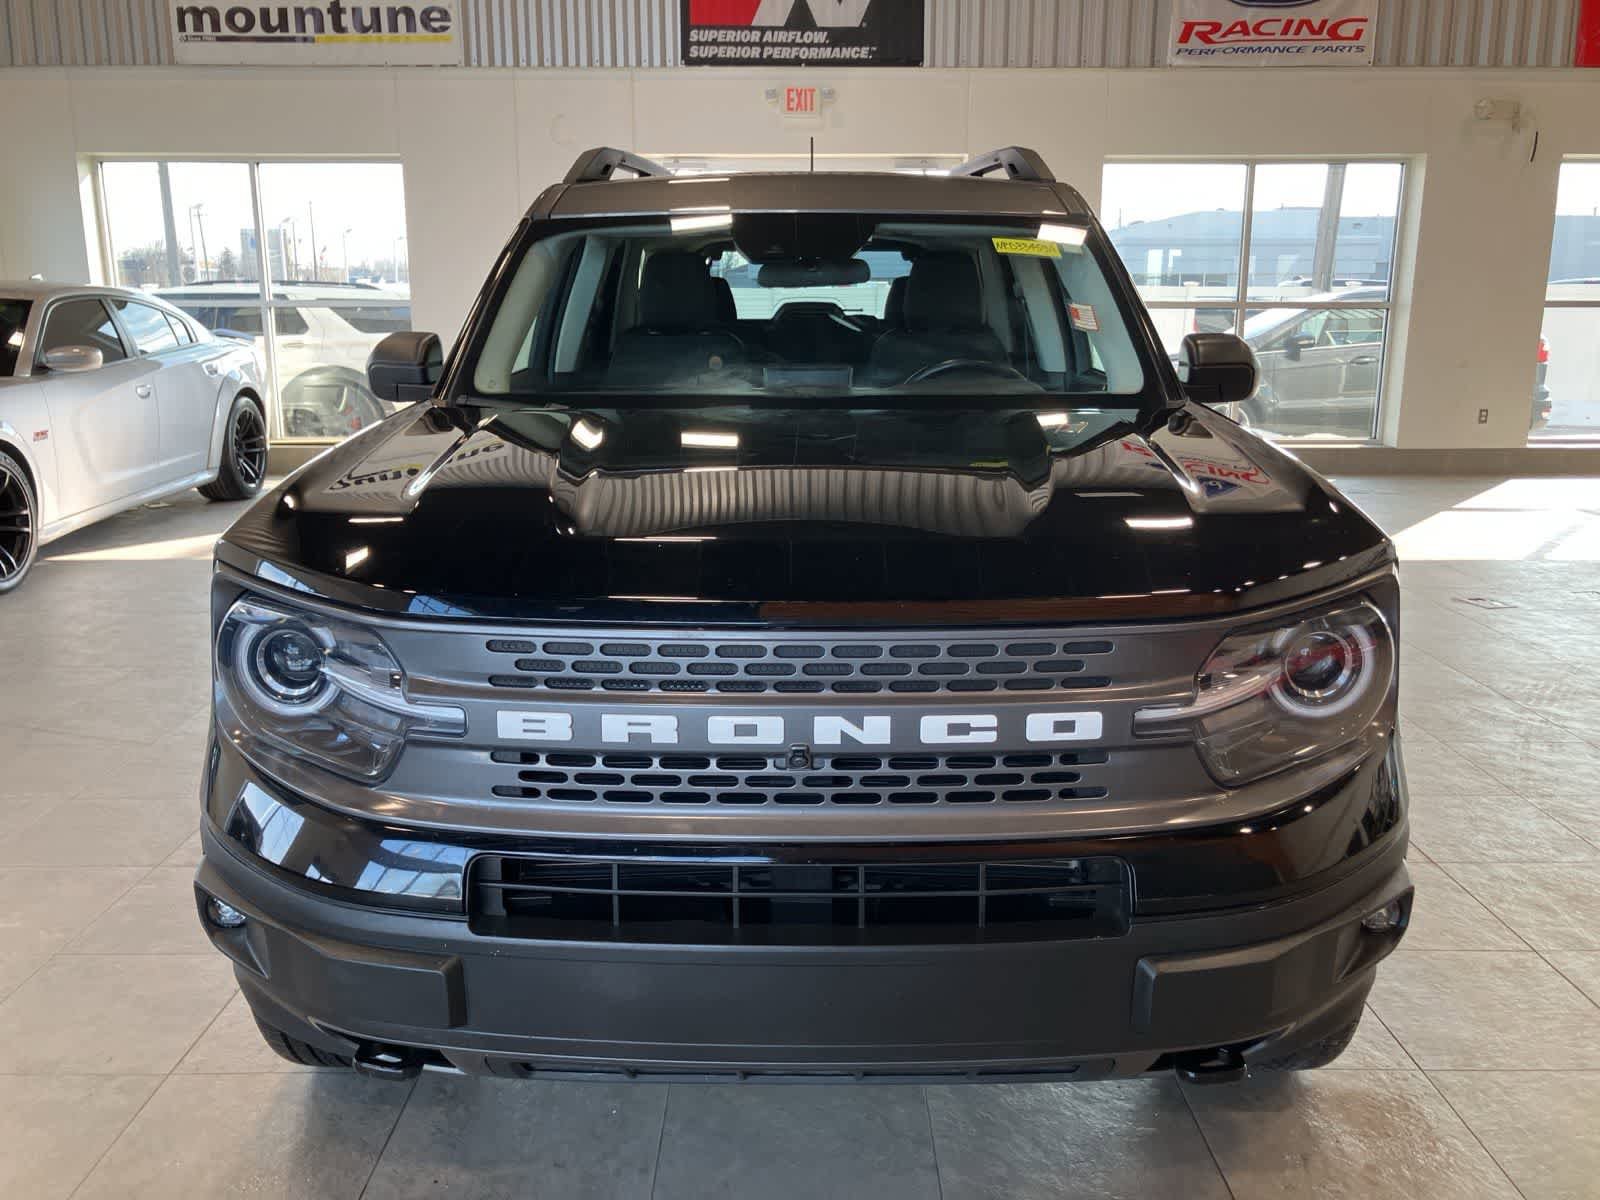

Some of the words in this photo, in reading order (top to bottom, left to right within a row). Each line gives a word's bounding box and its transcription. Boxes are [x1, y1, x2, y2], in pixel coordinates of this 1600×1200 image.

[176, 0, 452, 34] mountune
[689, 29, 760, 43] SUPERIOR
[762, 31, 830, 44] AIRFLOW.
[1177, 17, 1369, 45] RACING
[689, 45, 760, 59] SUPERIOR
[1176, 45, 1308, 56] PERFORMANCE
[1312, 45, 1367, 54] PARTS
[785, 87, 816, 112] EXIT
[497, 710, 1103, 745] BRONCO
